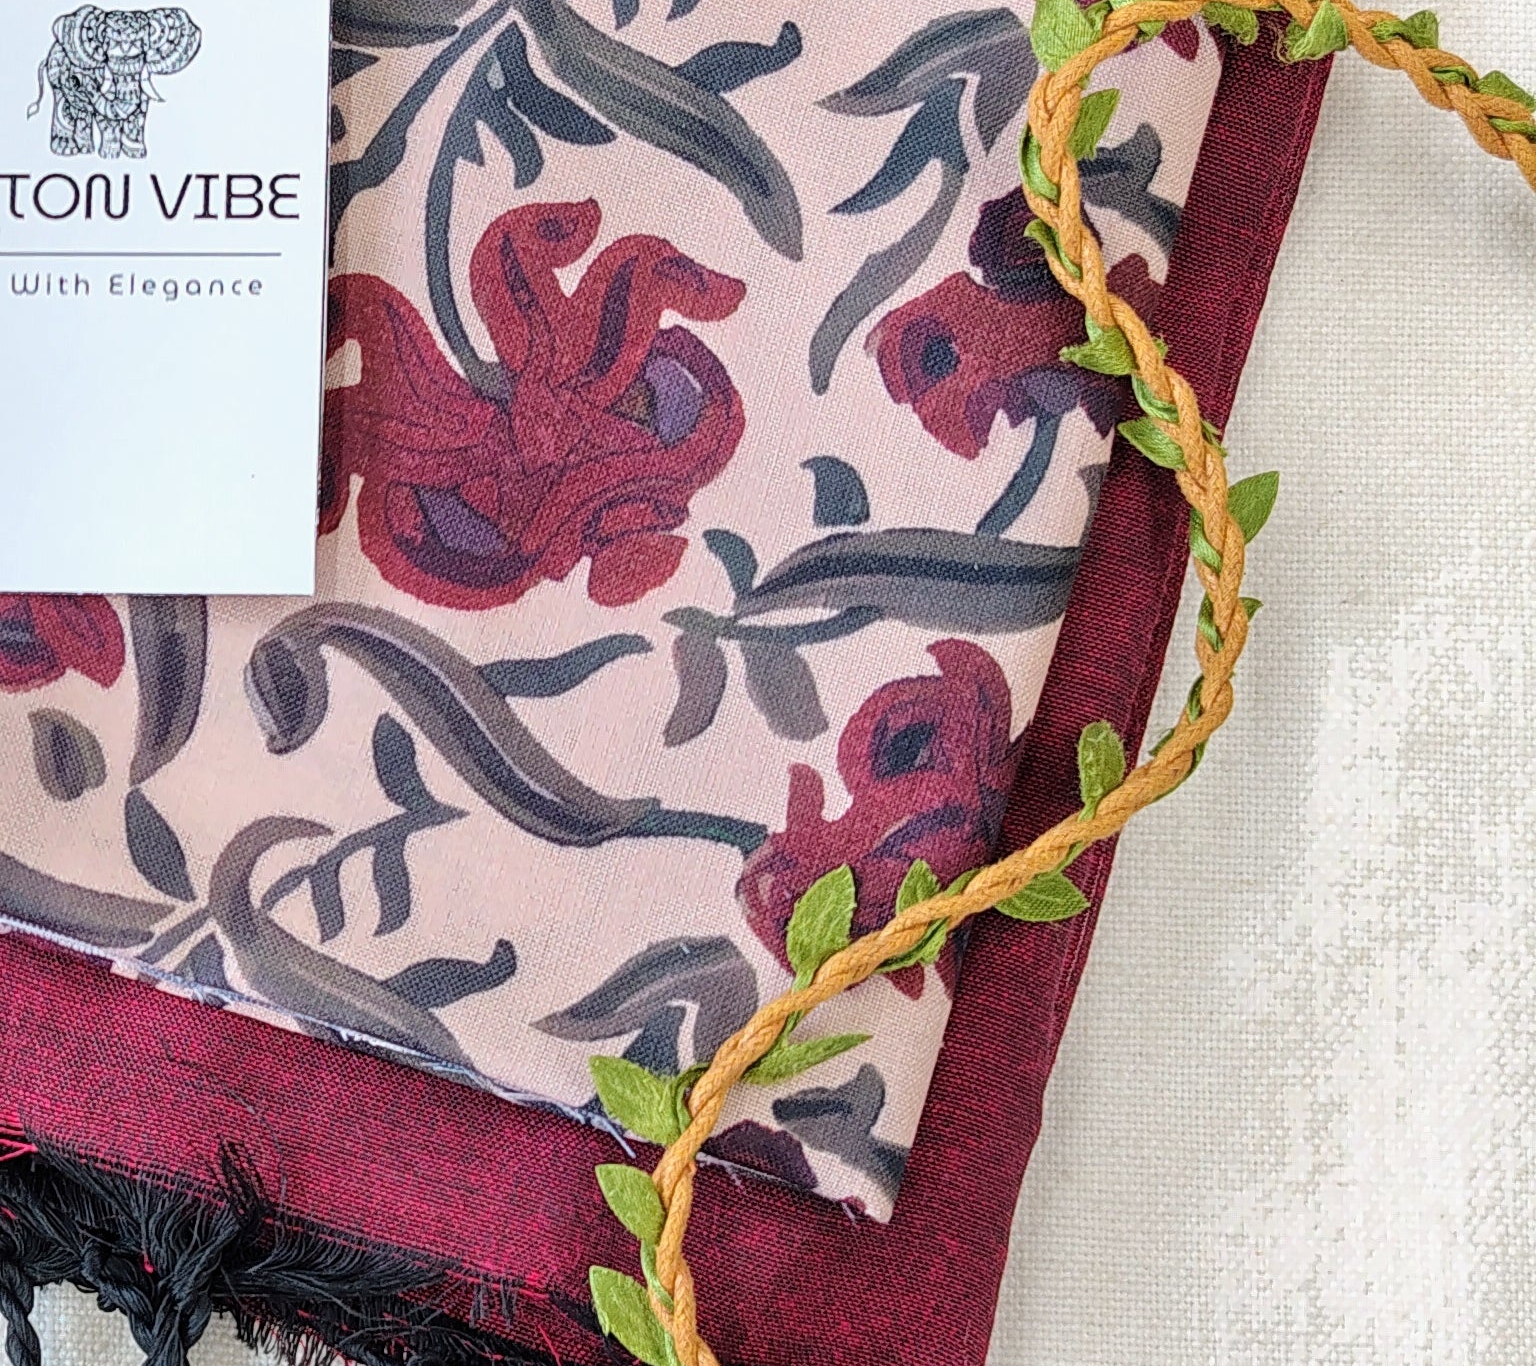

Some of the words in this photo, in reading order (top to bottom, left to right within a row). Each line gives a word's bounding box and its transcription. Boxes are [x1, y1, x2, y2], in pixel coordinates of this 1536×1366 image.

[149, 172, 301, 220] VIBE
[10, 273, 91, 297] With
[108, 273, 264, 302] Elegance
